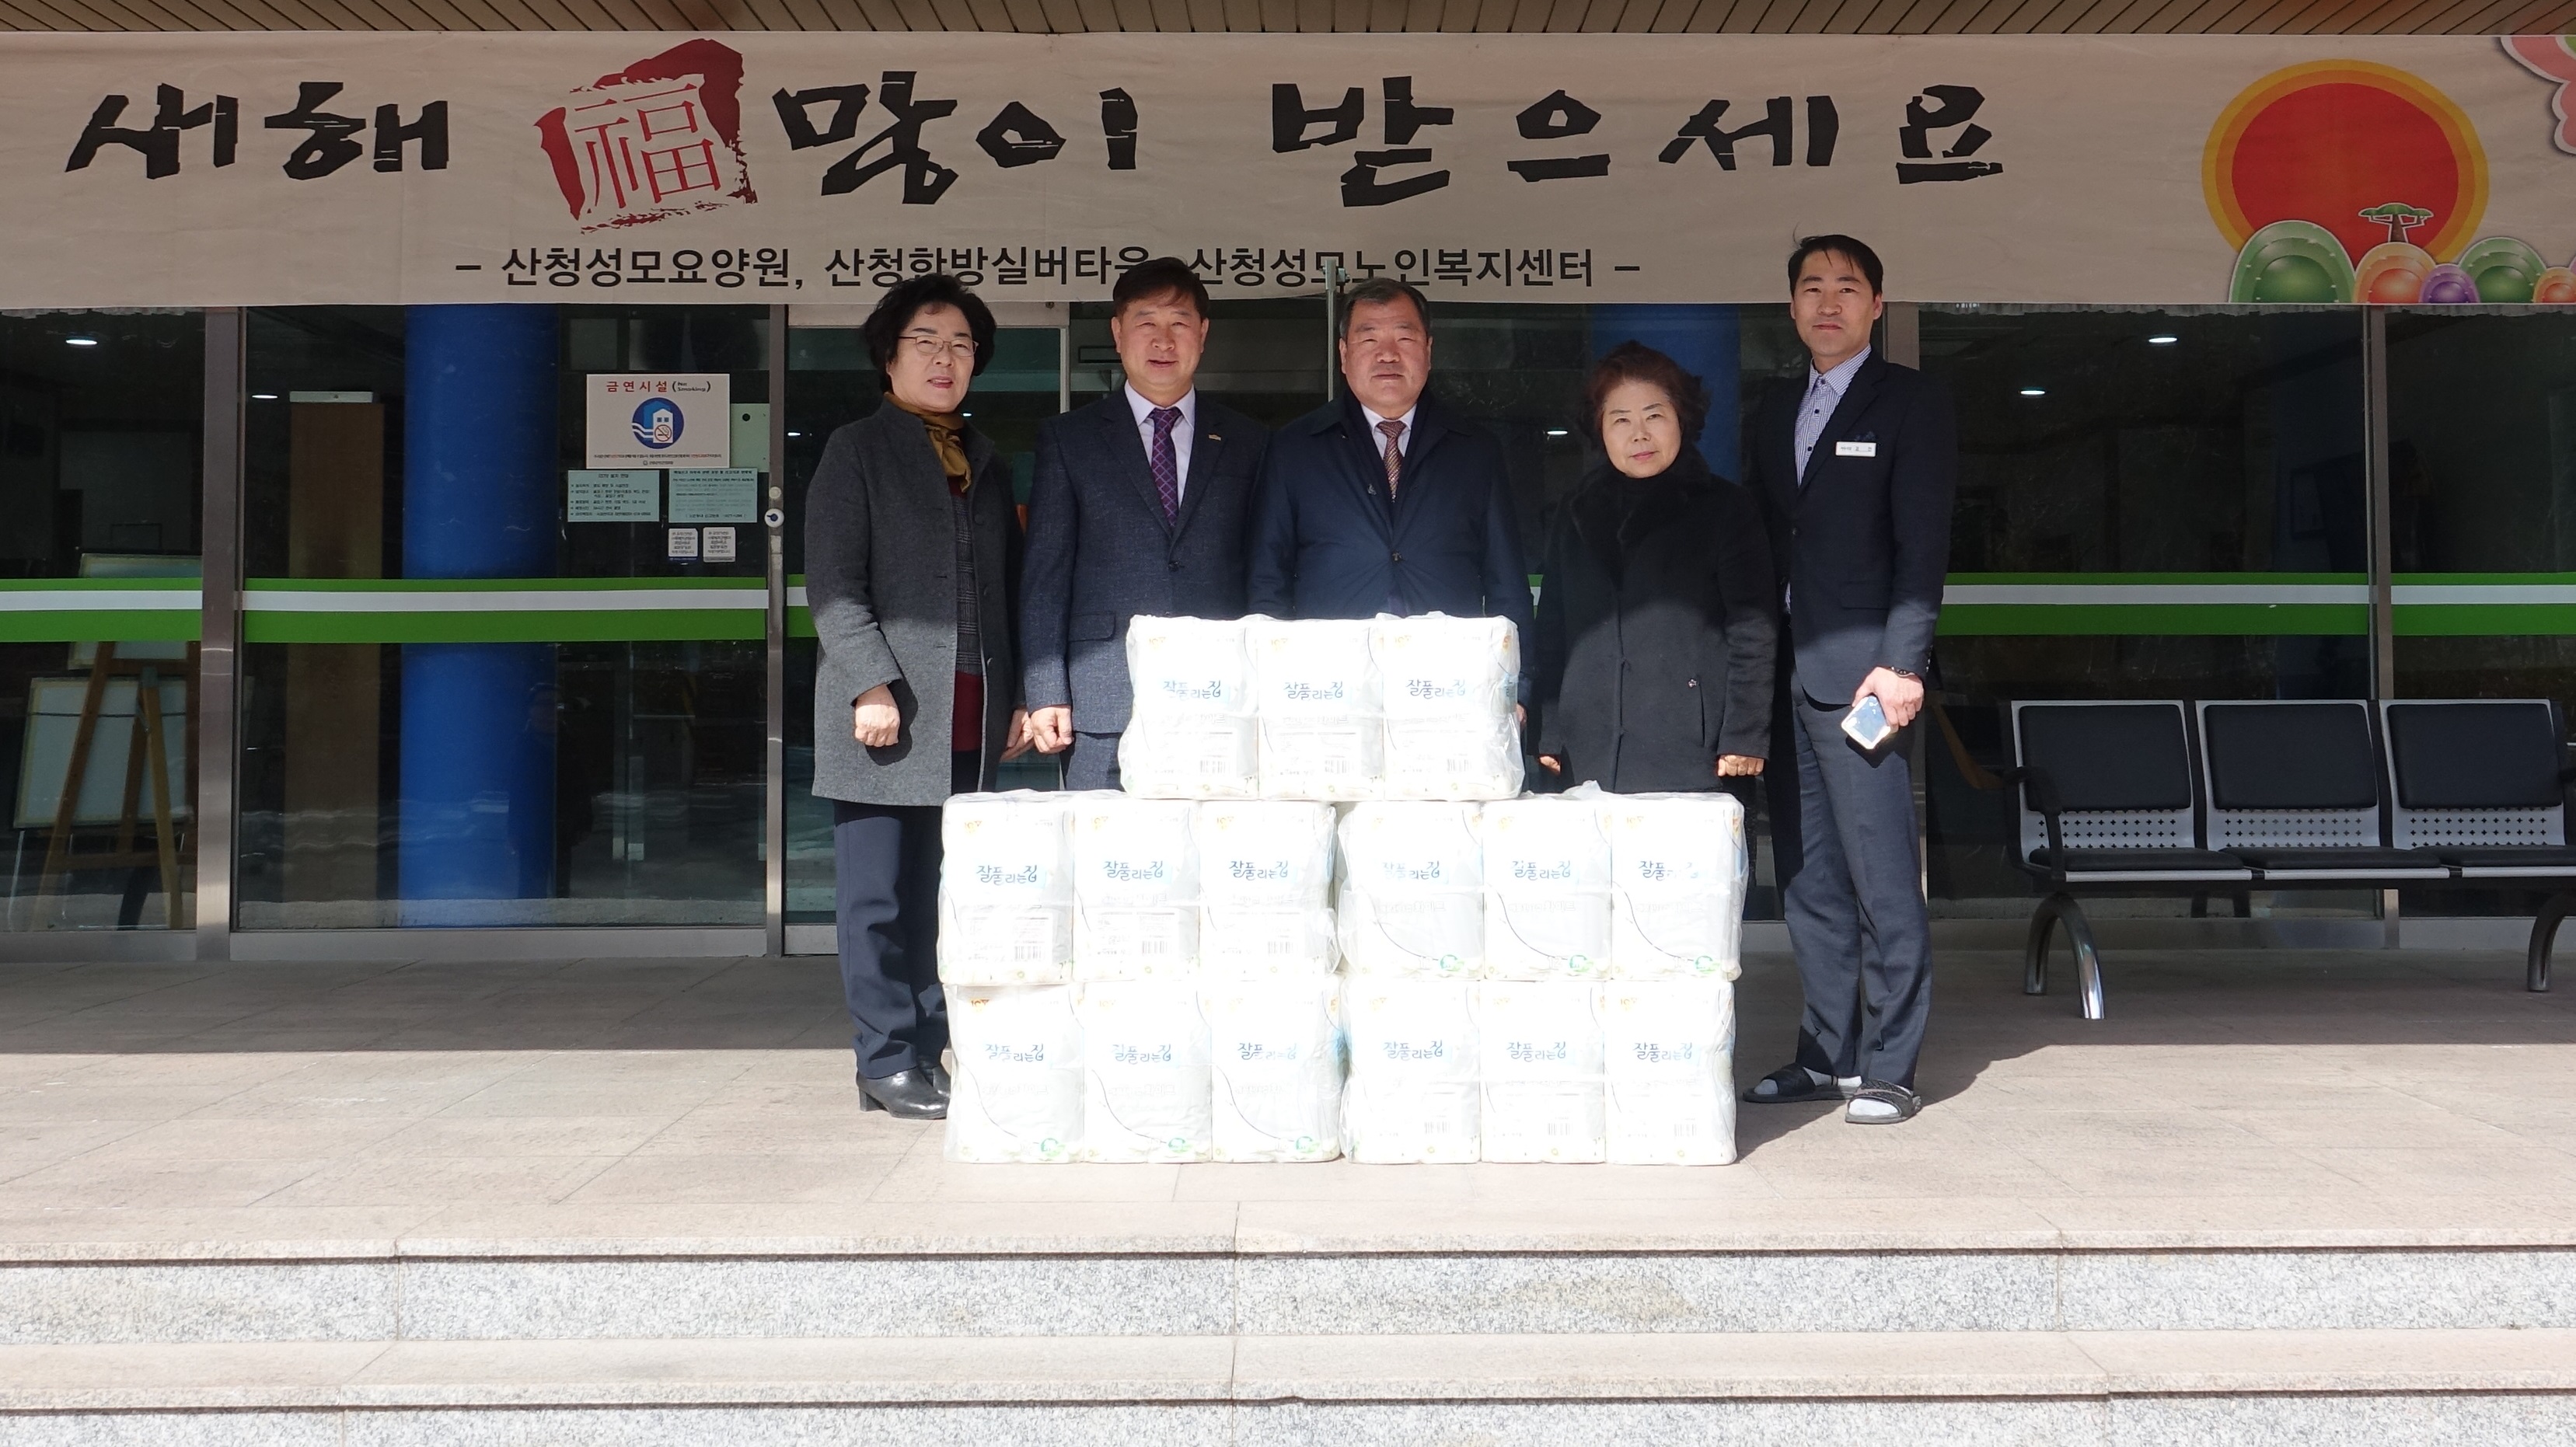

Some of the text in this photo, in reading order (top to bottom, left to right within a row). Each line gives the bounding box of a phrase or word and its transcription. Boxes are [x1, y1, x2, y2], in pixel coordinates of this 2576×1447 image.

[65, 71, 2004, 209] 새해 福 많이 받으세요
[501, 247, 803, 291] 산청성모요양원,
[606, 381, 668, 393] 금연시설
[1284, 681, 1343, 700] 잘풀리는집
[1405, 679, 1465, 700] 잘풀리는집
[976, 864, 1038, 886] 잘풀리는집
[1103, 860, 1164, 881] 잘풀리는집
[1228, 860, 1288, 881] 잘풀리는집
[1110, 1043, 1171, 1064] 잘풀리는집
[1384, 1040, 1443, 1061] 잘풀리는집
[1507, 1040, 1566, 1062] 잘풀리는집
[1633, 1041, 1693, 1063] 잘풀리는집
